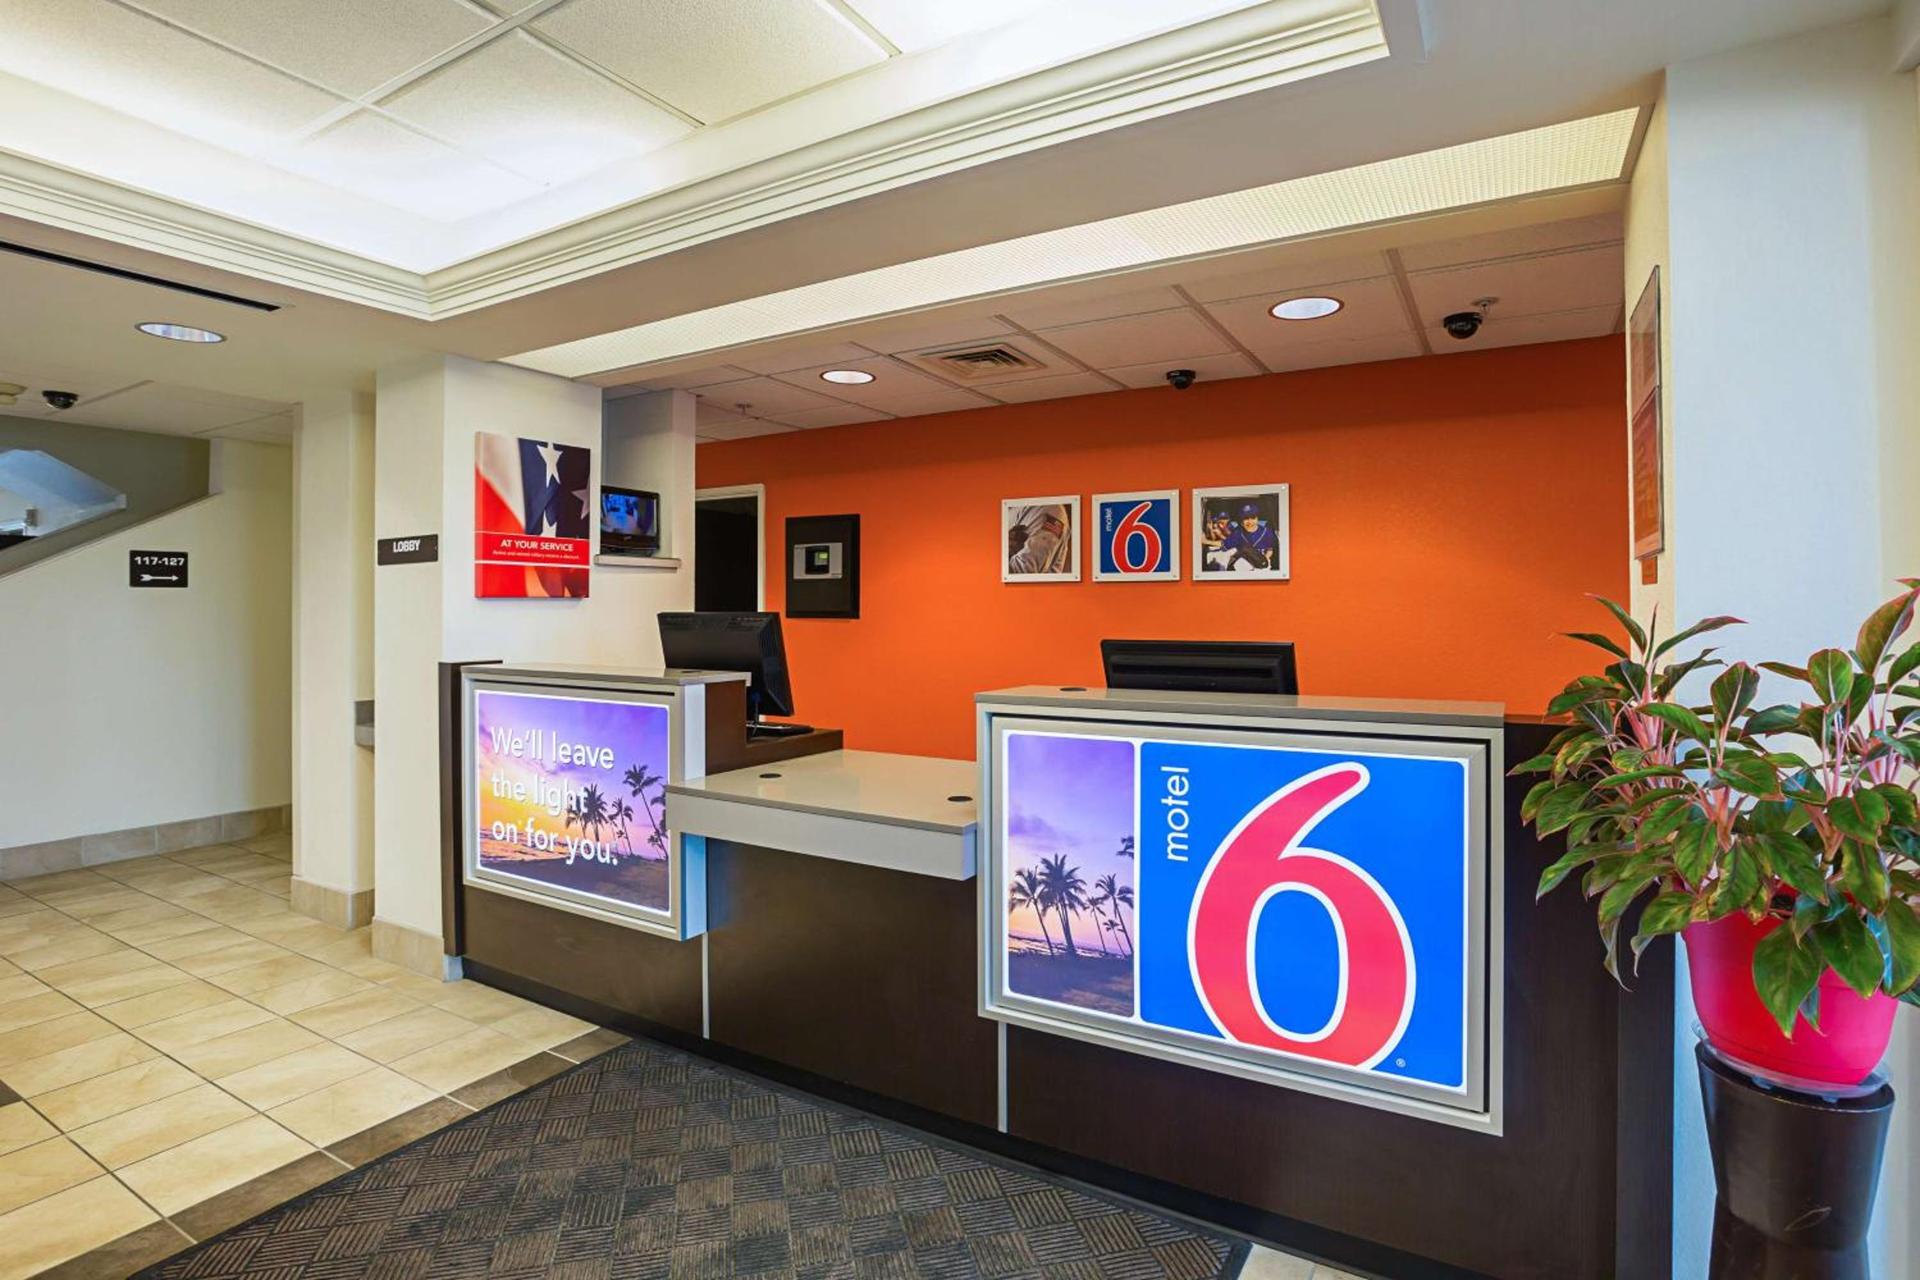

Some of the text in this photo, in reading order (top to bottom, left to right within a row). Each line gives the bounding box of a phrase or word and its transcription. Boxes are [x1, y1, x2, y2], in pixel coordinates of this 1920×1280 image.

[393, 539, 421, 553] LOBBY
[500, 539, 574, 552] AT YOUR SERVICE
[1111, 501, 1162, 574] 6
[134, 556, 185, 566] 117-127
[491, 726, 615, 769] We'll leave
[492, 768, 588, 817] the light
[492, 816, 619, 866] on for you.
[1160, 761, 1416, 1070] motel 6
